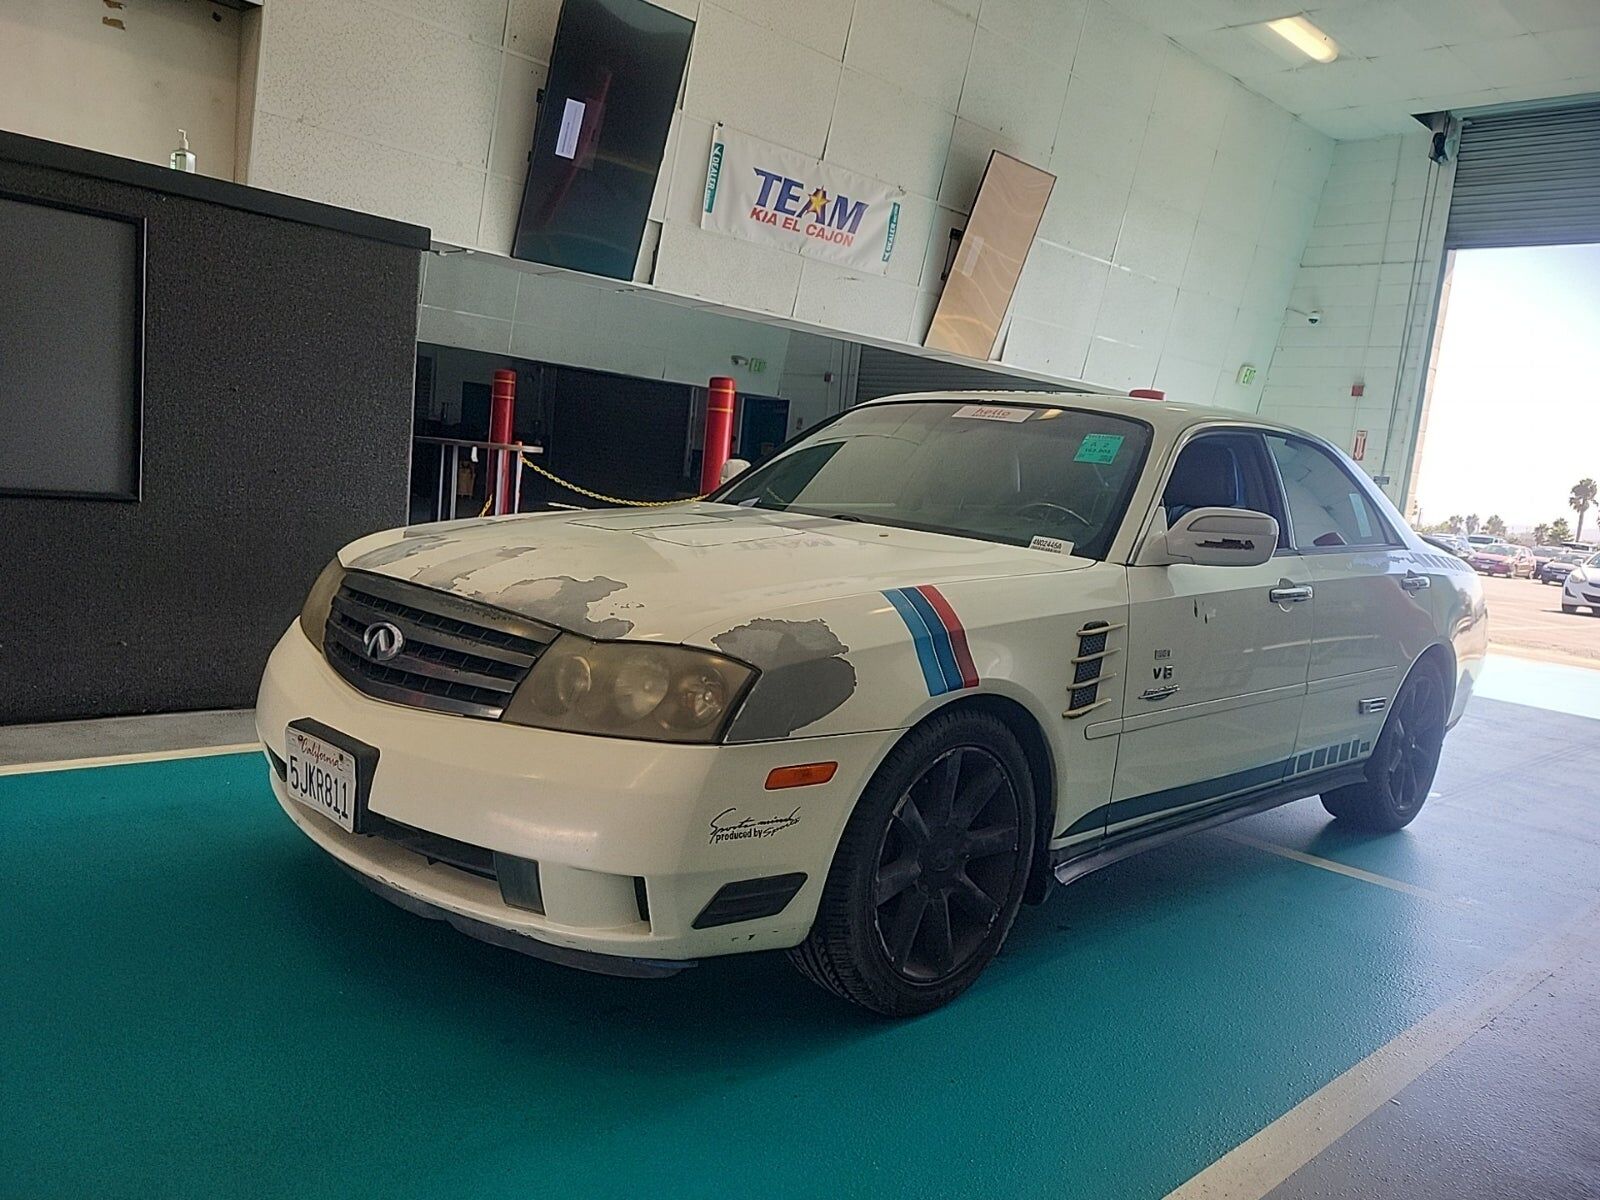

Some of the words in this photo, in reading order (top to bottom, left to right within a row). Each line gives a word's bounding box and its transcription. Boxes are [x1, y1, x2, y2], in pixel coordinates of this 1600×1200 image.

[708, 157, 721, 190] DEALER
[753, 167, 869, 234] TEAM
[751, 207, 777, 226] KIA
[782, 216, 800, 232] EL
[805, 224, 854, 247] CAJON
[301, 737, 344, 771] California
[290, 755, 348, 819] 5JKR811
[715, 828, 752, 844] produced
[753, 828, 762, 838] by
